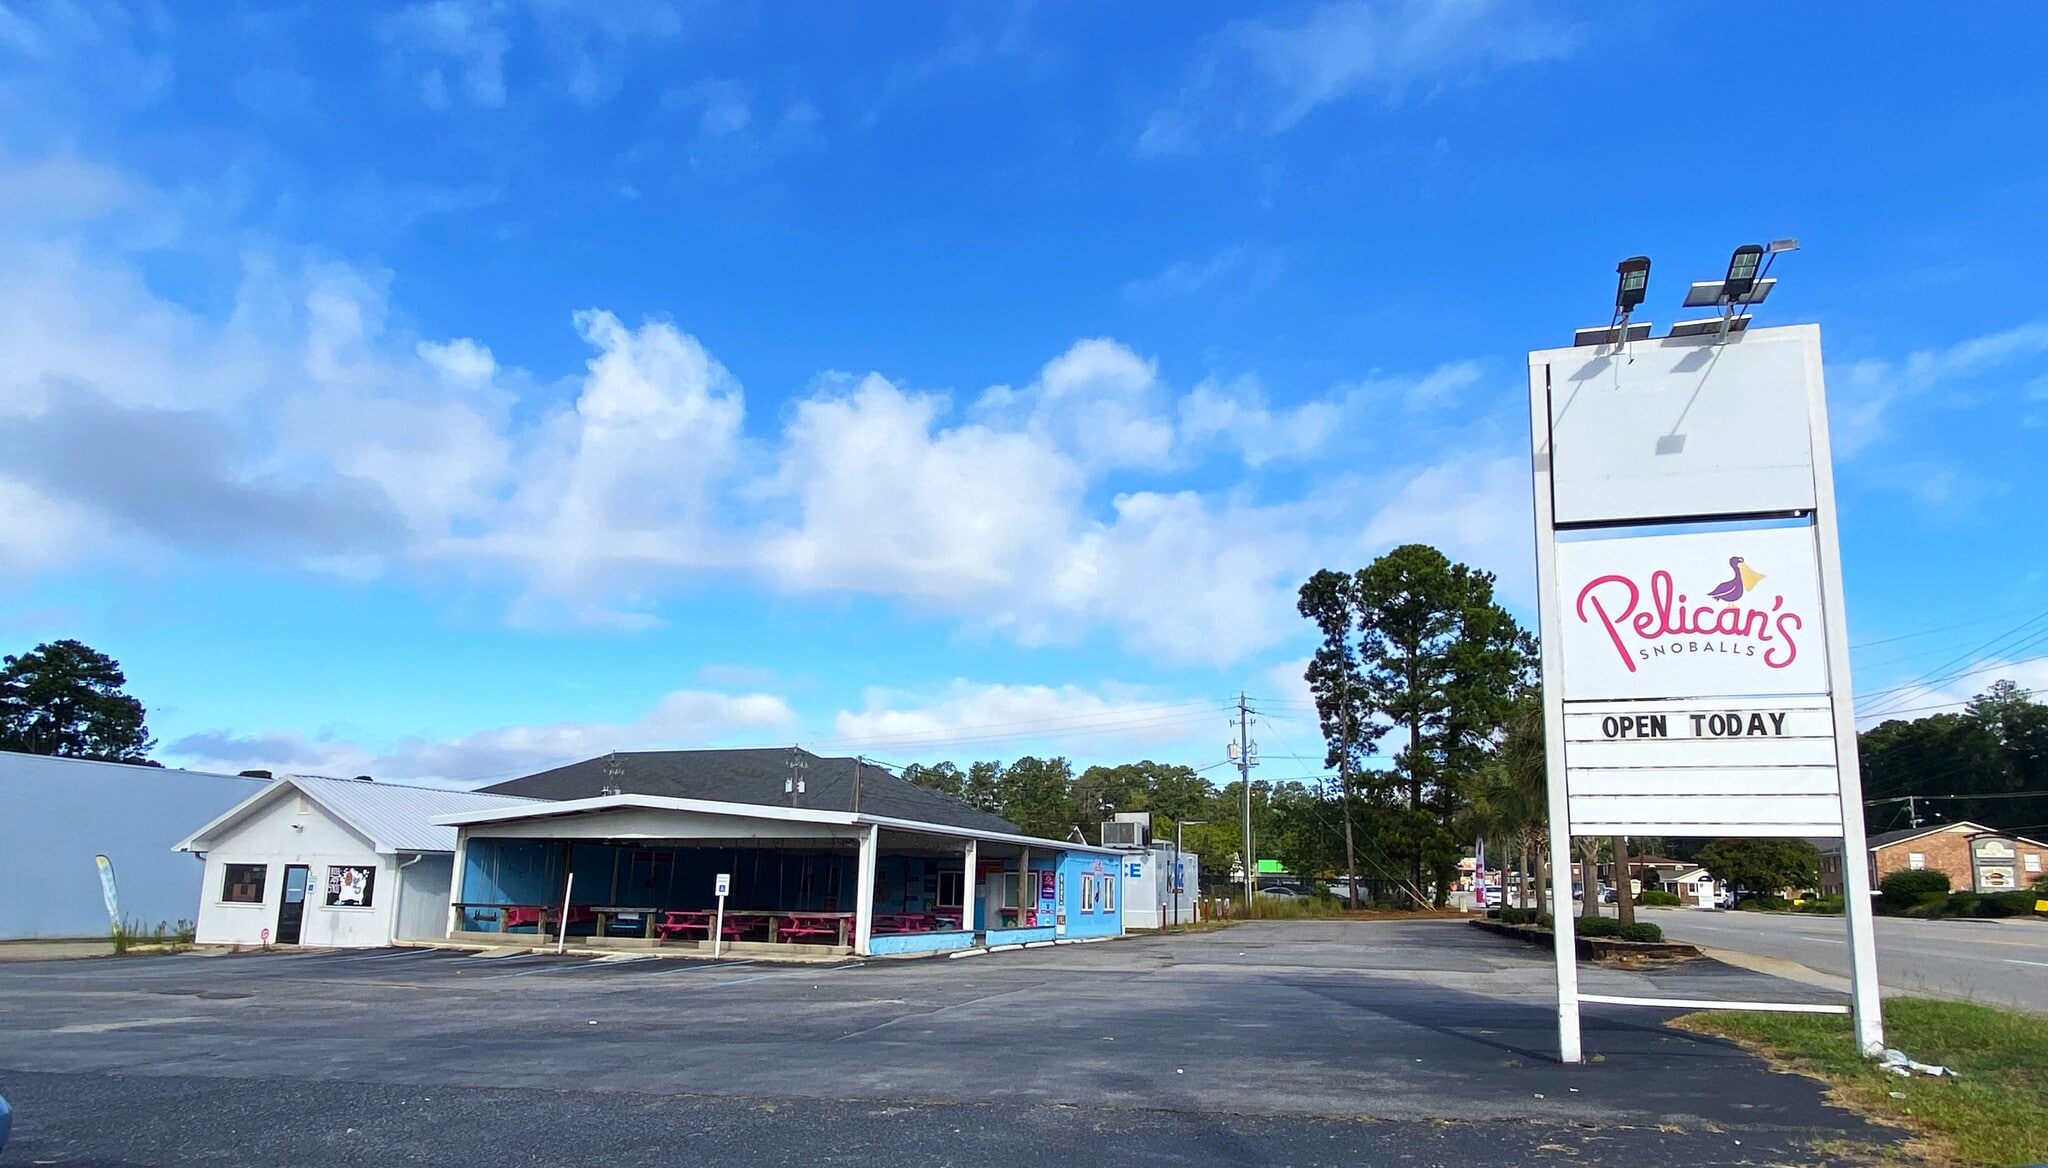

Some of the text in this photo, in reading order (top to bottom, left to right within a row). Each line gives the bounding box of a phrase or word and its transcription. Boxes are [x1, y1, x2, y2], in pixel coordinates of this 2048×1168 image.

[1577, 570, 1802, 673] Pelican's
[1640, 641, 1756, 660] SNOBALLS
[1602, 714, 1785, 738] OPEN TODAY
